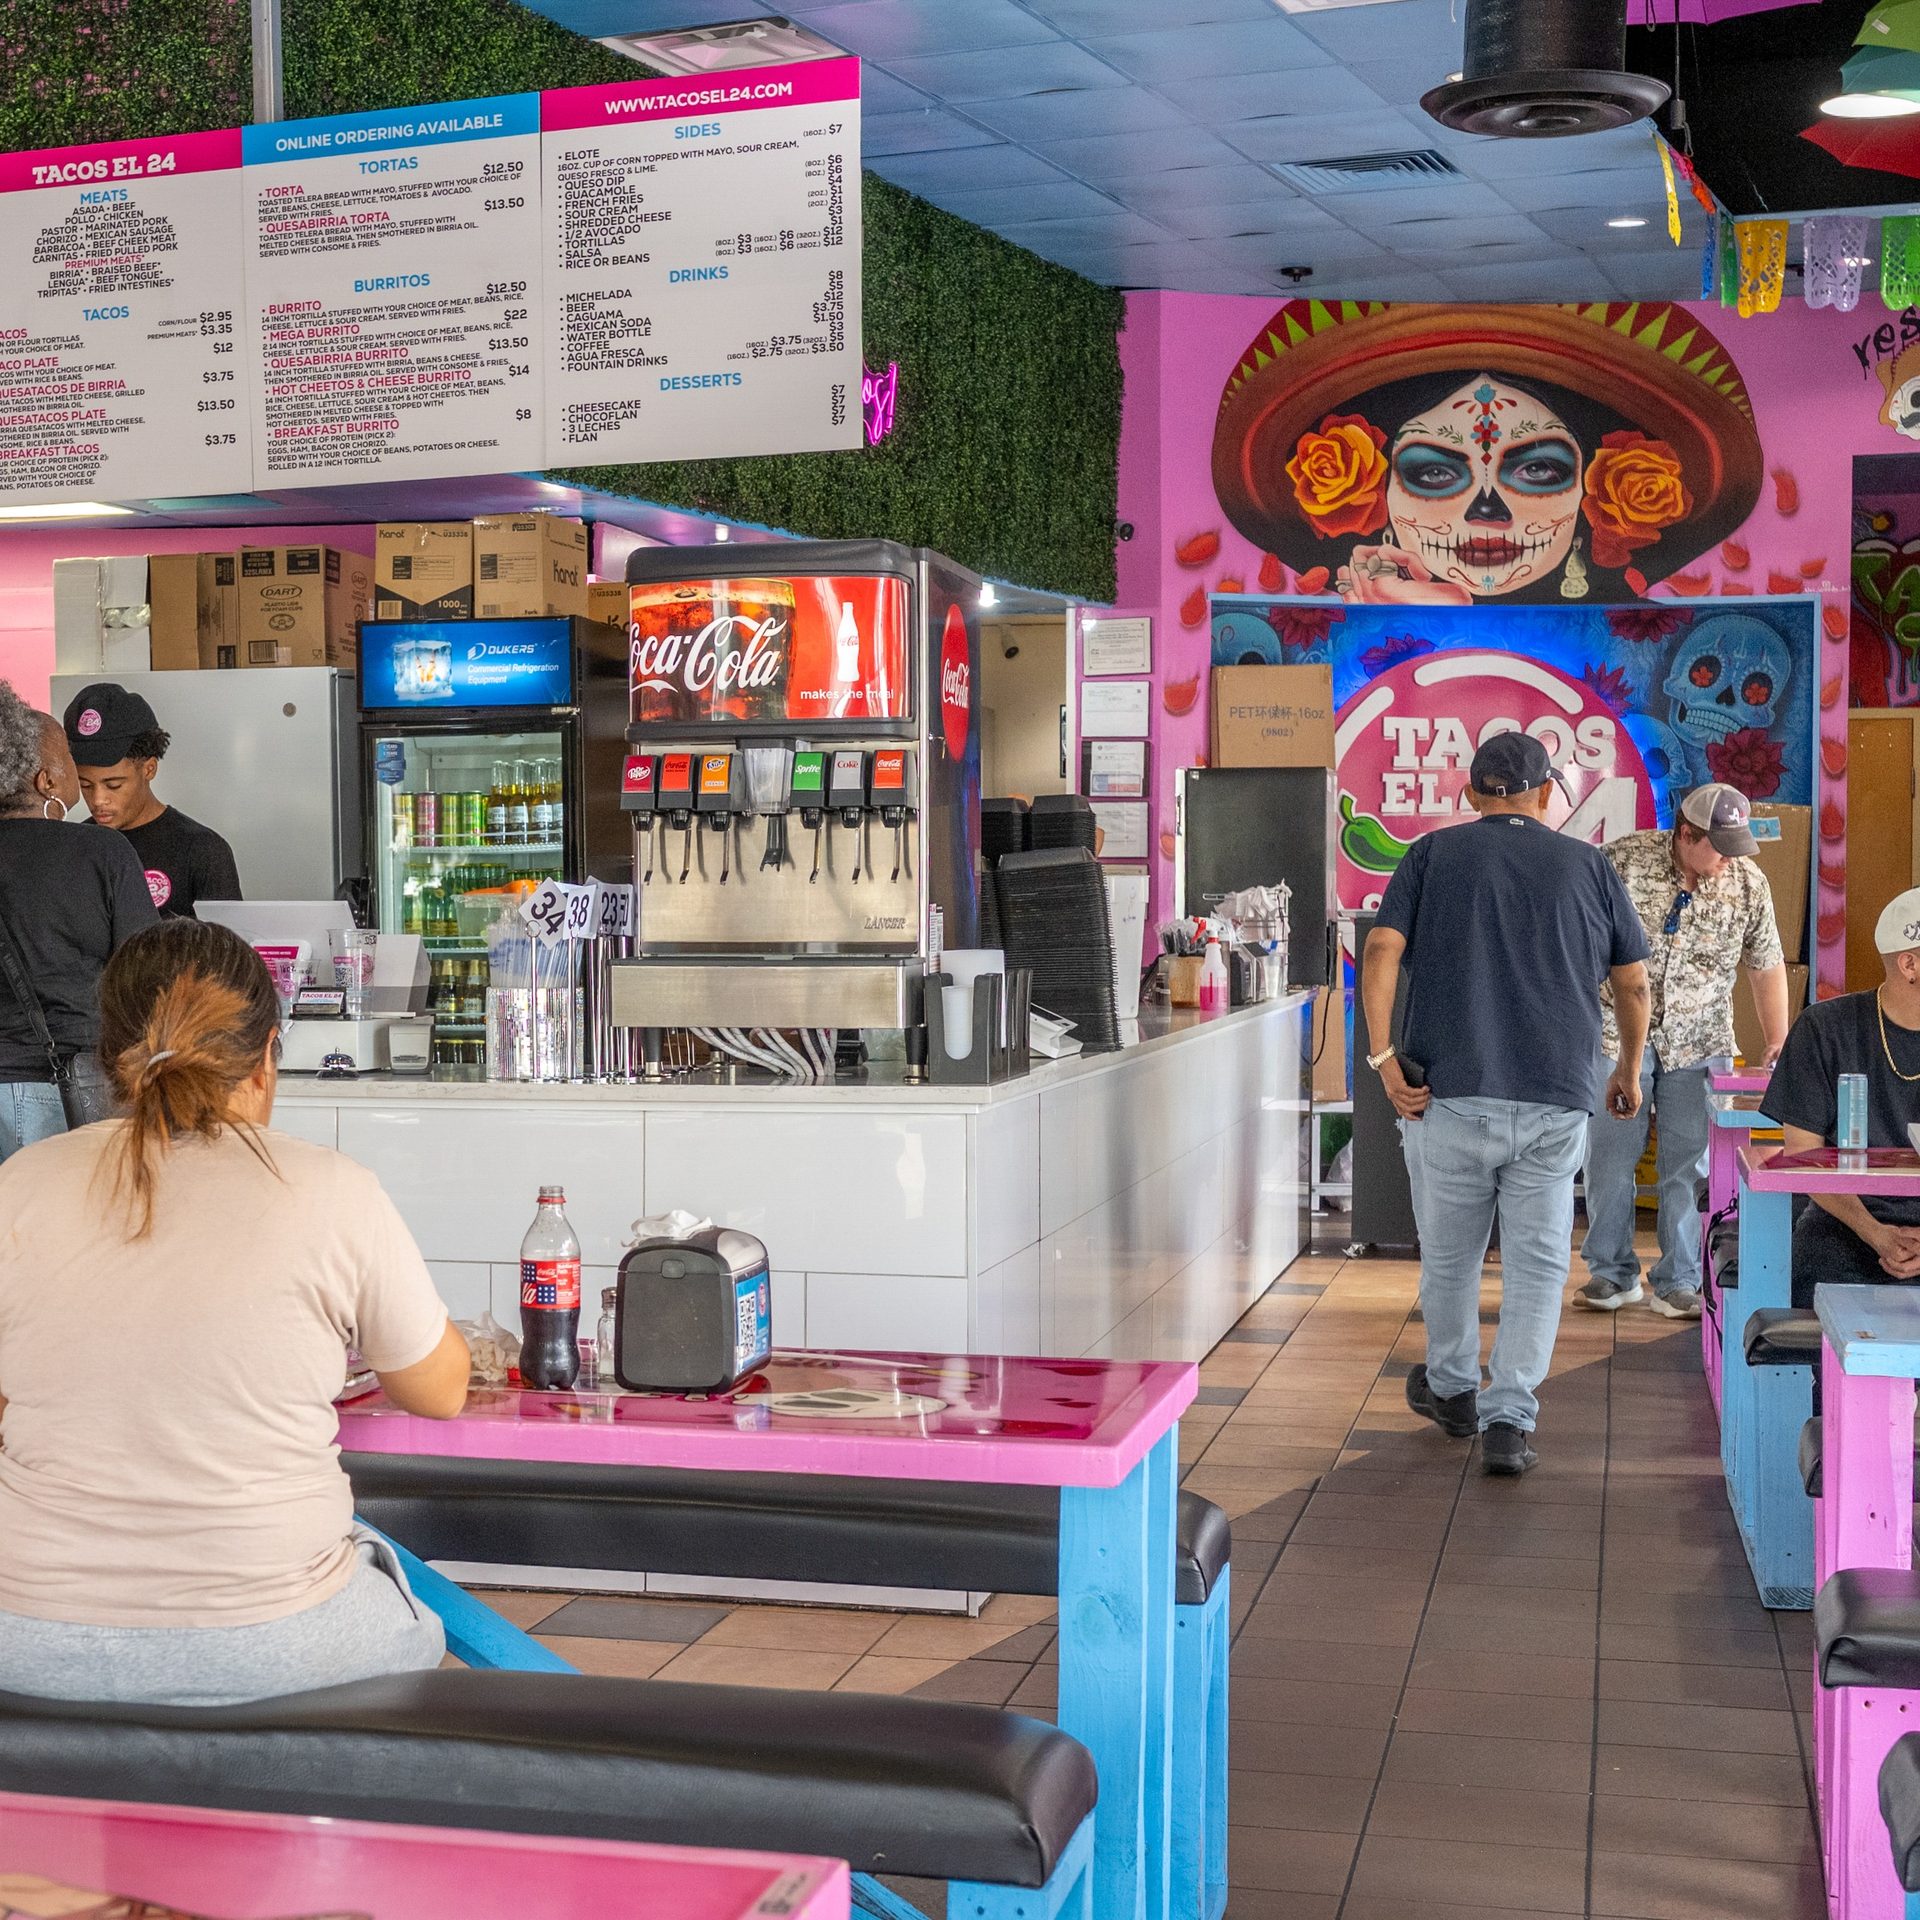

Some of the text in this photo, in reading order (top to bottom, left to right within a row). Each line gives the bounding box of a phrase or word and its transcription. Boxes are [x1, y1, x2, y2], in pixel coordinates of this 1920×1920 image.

[605, 82, 792, 114] WWW.TACOSEL24.COM
[276, 114, 503, 151] ONLINE ORDERING AVAILABLE
[675, 123, 721, 139] SIDES
[828, 123, 842, 135] $7
[565, 149, 600, 161] ELOTE
[32, 153, 176, 185] TACOS EL 24
[360, 157, 418, 174] TORTAS
[483, 160, 524, 175] $12.50
[565, 176, 625, 190] QUESO DIP
[80, 189, 128, 204] MEATS
[265, 185, 304, 198] TORTA
[565, 185, 636, 200] GUACAMOLE
[73, 202, 135, 215] ASADA BEEF
[484, 197, 524, 211] $13.50
[565, 194, 644, 210] FRENCH FRIES
[65, 210, 143, 225] POLLO CHICKEN
[565, 204, 638, 219] SOUR CREAM
[42, 217, 168, 236] PASTOR MARINATED PORK
[266, 211, 389, 233] QUESABIRRIA TORTA
[565, 211, 671, 229] SHREDDED CHEESE
[37, 226, 173, 245] CHORIZO MEXICAN SAUSAGE
[565, 224, 641, 239] 1/2 AVOCADO
[565, 235, 625, 248] TORTILLAS
[565, 247, 602, 258] SALSA
[566, 253, 650, 268] RICE OR BEANS
[669, 266, 729, 282] DRINKS
[828, 269, 844, 280] $8
[354, 274, 430, 292] BURRITOS
[486, 281, 527, 294] $12.50
[829, 279, 844, 290] $5
[566, 289, 632, 302] MICHELADA
[824, 290, 844, 301] $12
[269, 301, 321, 314] BURRITO
[566, 301, 595, 312] BEER
[812, 300, 844, 312] $3.75
[83, 307, 129, 321] TACOS
[200, 311, 232, 323] $2.95
[504, 309, 527, 321] $22
[566, 309, 623, 322] CAGUAMA
[813, 310, 844, 322] $1.50
[200, 324, 232, 335] $3.35
[566, 317, 651, 332] MEXICAN SODA
[829, 320, 843, 331] $3
[270, 324, 360, 341] MEGA BURRITO
[566, 327, 651, 342] WATER BOTTLE
[829, 331, 844, 341] $5
[489, 336, 528, 349] $13.50
[567, 340, 610, 351] COFFEE
[770, 334, 802, 346] $3.75
[213, 342, 233, 353] $12
[752, 346, 783, 358] $2.75
[812, 341, 844, 353] $3.50
[271, 348, 408, 369] QUESABIRRIA BURRITO
[567, 348, 644, 361] AGUA FRESCA
[508, 364, 529, 376] $14
[567, 356, 668, 371] FOUNTAIN DRINKS
[203, 371, 234, 383] $3.75
[272, 370, 471, 395] HOT CHEETOS & CHEESE BURRITO
[660, 372, 742, 391] DESSERTS
[70, 383, 84, 392] DE
[87, 380, 126, 391] BIRRIA
[831, 384, 845, 395] $7
[197, 399, 235, 412] $13.50
[568, 399, 641, 413] CHEESECAKE
[71, 410, 106, 421] PLATE
[516, 409, 531, 420] $8
[568, 410, 637, 423] CHOCOFLAN
[274, 420, 399, 438] BREAKFAST BURRITO
[569, 421, 620, 433] 3 LECHES
[205, 434, 236, 446] $3.75
[569, 432, 598, 443] FLAN
[64, 444, 99, 455] TACOS
[266, 587, 297, 596] DART
[438, 600, 460, 608] 1000
[488, 645, 535, 655] DUKERS
[468, 663, 559, 674] Commercial Refrigeration
[468, 675, 507, 685] Equipment
[943, 658, 969, 709] Coca-Cola
[800, 688, 840, 699] makes
[1261, 727, 1294, 738] (9802)
[795, 764, 820, 775] Sprite
[837, 760, 859, 769] Coke
[1381, 773, 1452, 816] EL
[531, 891, 565, 936] 34
[568, 894, 590, 930] 38
